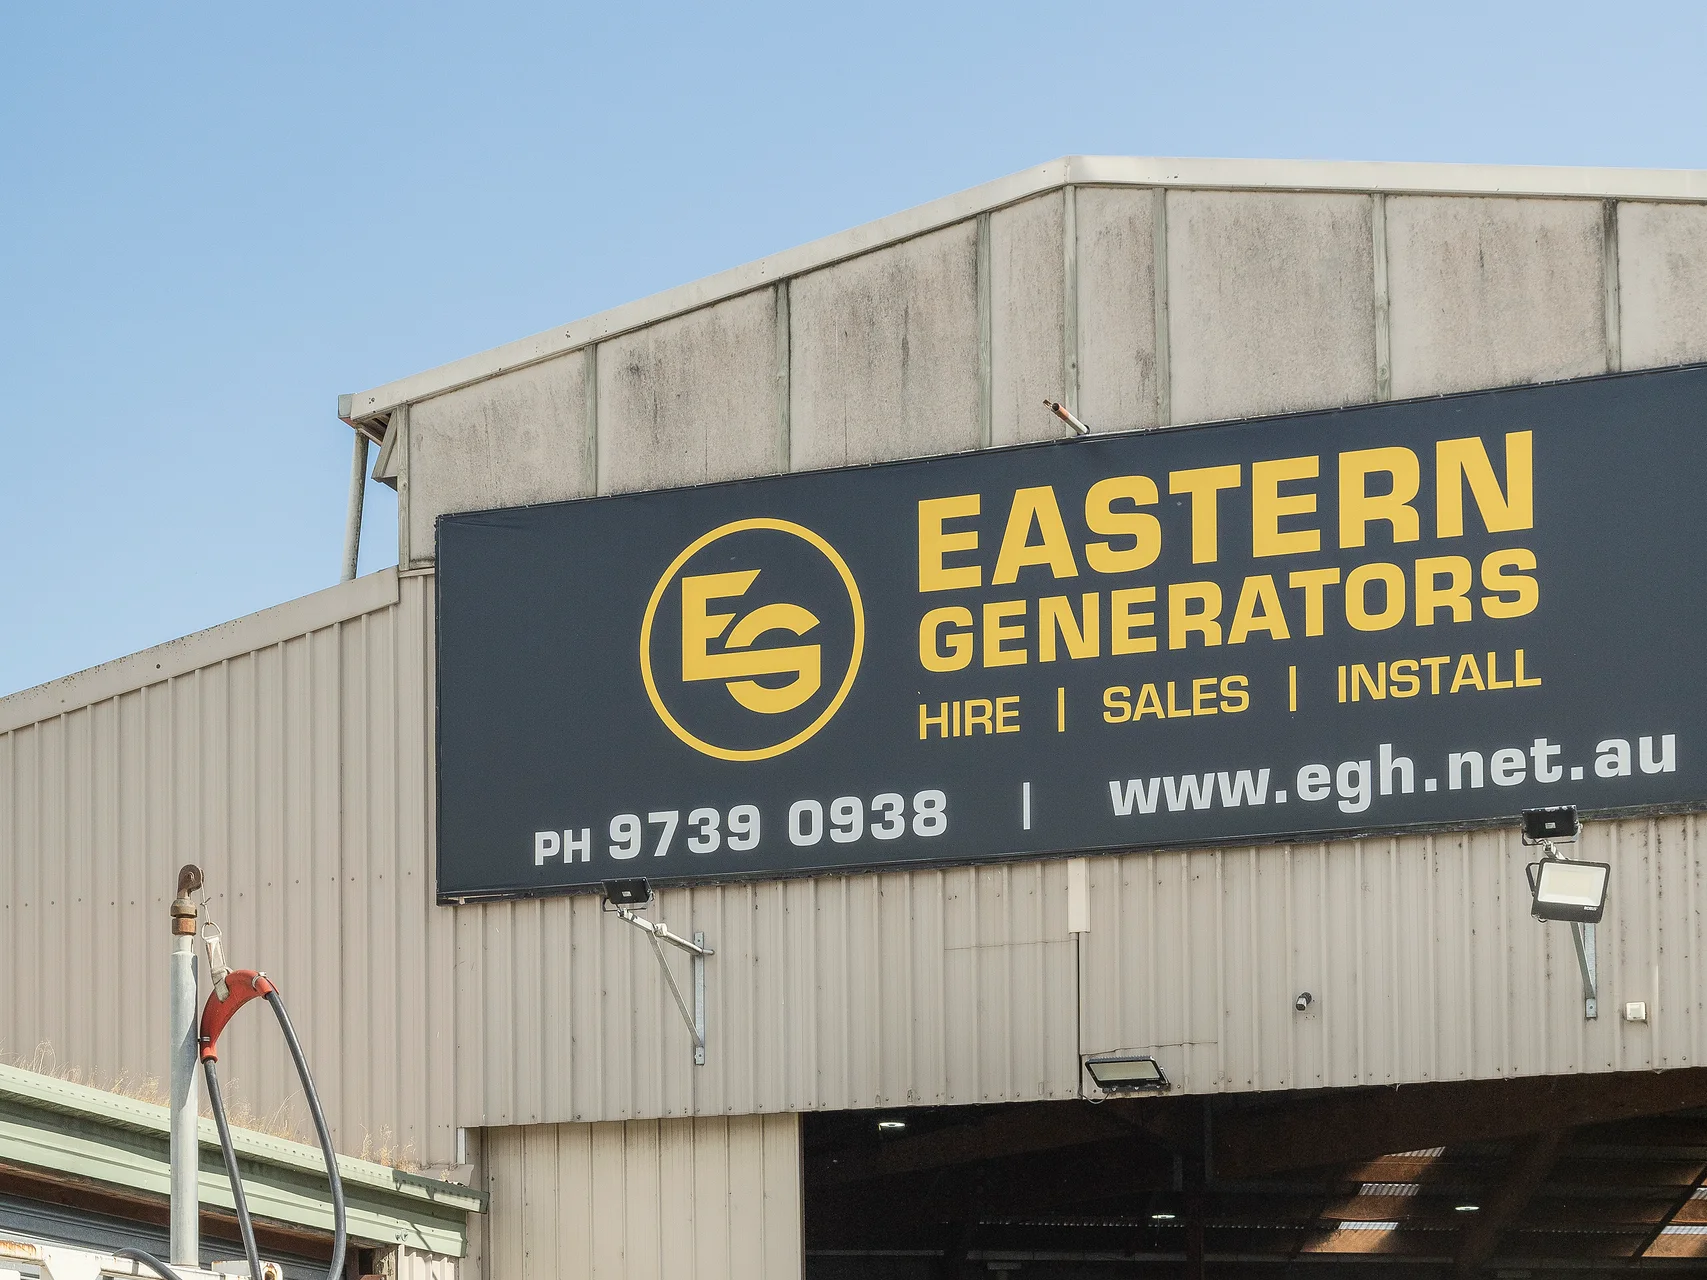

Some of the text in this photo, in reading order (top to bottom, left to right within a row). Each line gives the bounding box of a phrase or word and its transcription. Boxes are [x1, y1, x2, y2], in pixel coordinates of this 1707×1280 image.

[917, 430, 1534, 593] EASTERN
[681, 568, 822, 714] EG
[918, 547, 1540, 673] GENERATORS
[918, 648, 1542, 740] HIRE SALES INSTALL
[533, 788, 948, 867] PH 9739 0938
[1108, 733, 1678, 817] www.egh.net.au
